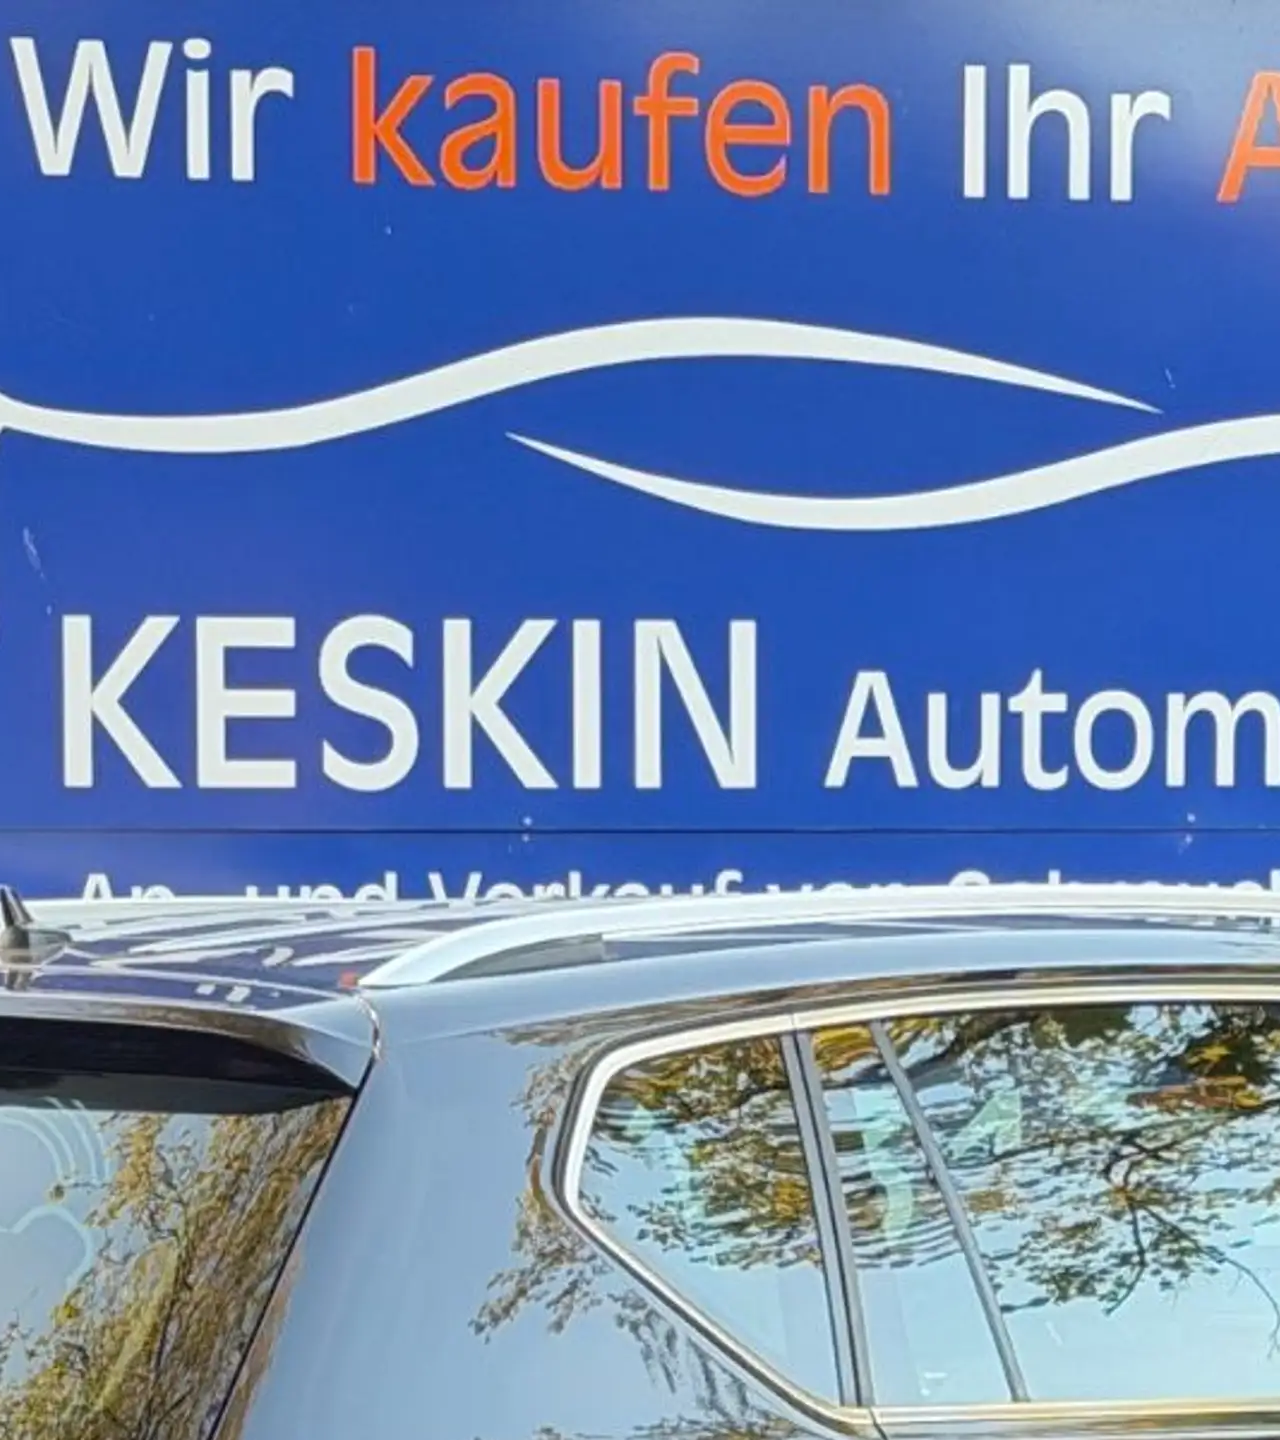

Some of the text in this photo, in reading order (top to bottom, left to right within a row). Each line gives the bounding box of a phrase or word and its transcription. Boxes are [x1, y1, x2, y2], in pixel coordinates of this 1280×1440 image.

[10, 37, 294, 181] Wir
[352, 46, 891, 197] kaufen
[962, 63, 1170, 202] Ihr
[62, 614, 757, 792] KESKIN
